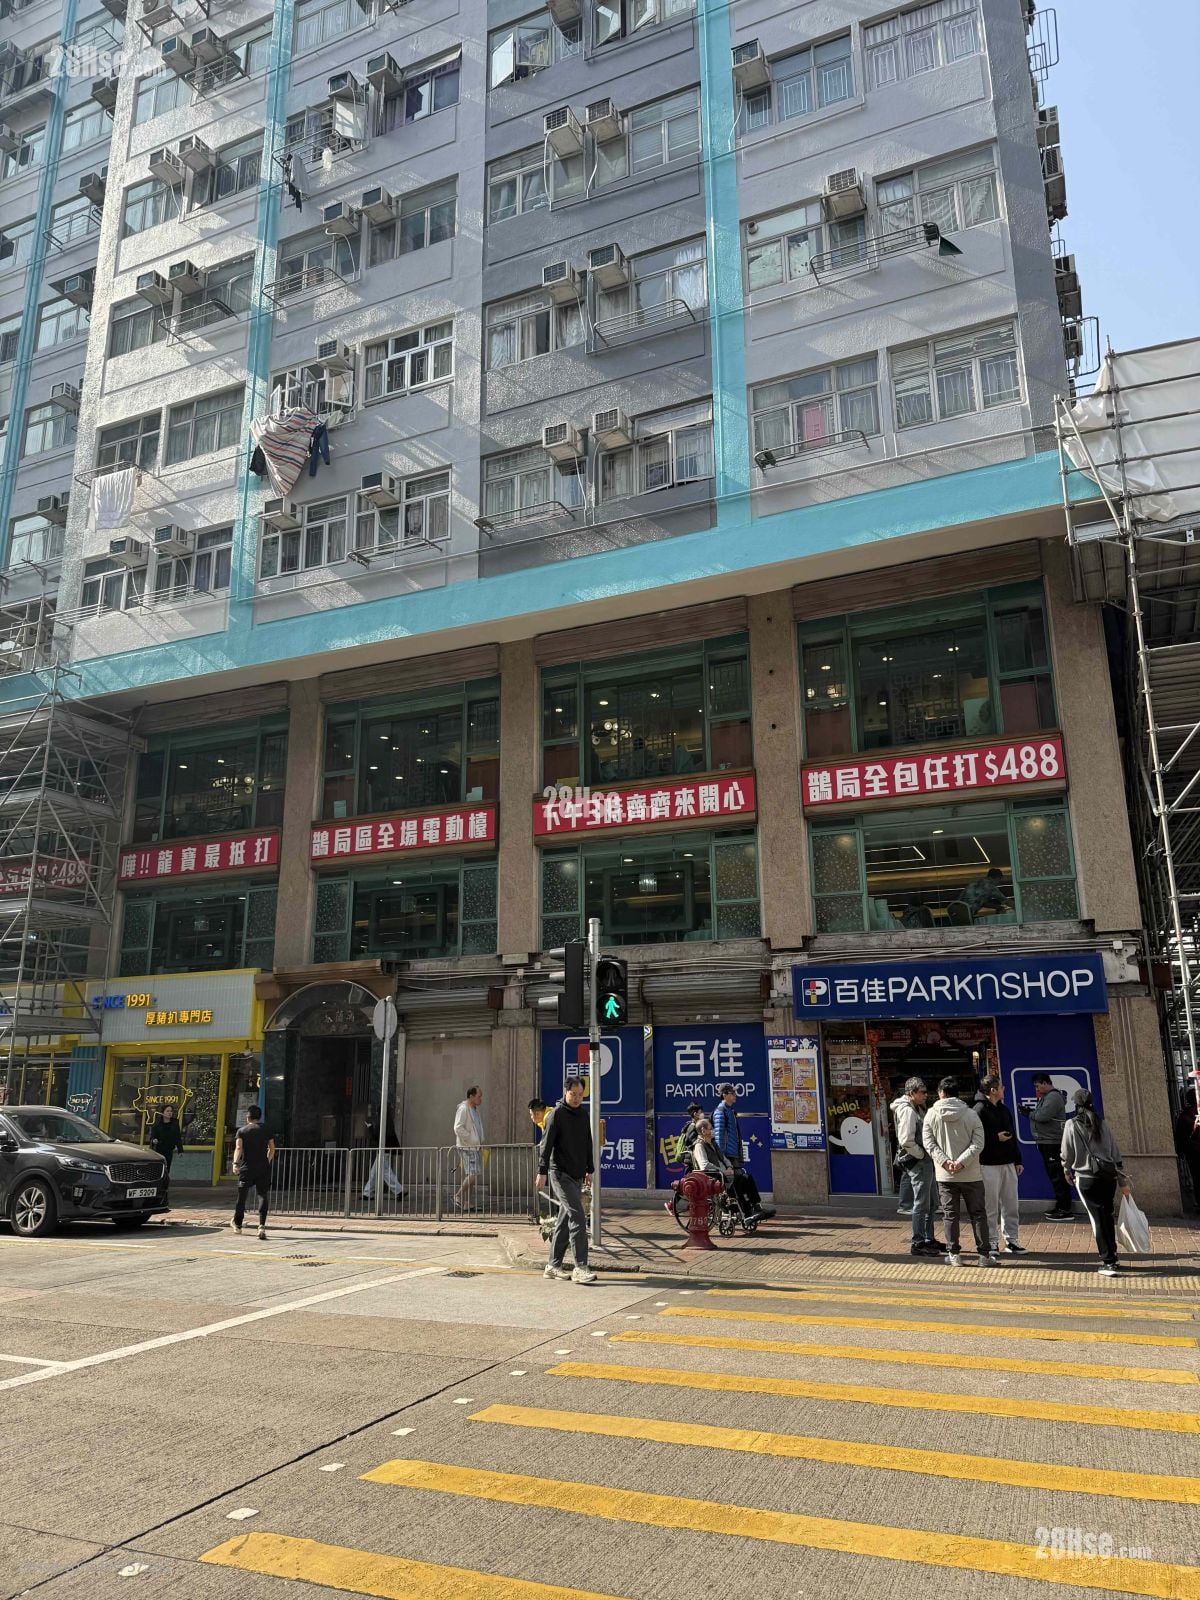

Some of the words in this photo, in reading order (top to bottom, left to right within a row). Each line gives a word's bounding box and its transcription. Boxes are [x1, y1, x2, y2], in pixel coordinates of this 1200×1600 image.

[834, 977, 887, 1004] 百佳
[92, 995, 124, 1009] SNCE
[126, 994, 151, 1008] 1991
[673, 1038, 745, 1077] 百佳
[665, 1083, 755, 1098] PARKnSOP
[164, 1095, 179, 1103] 1991
[827, 1099, 860, 1117] Hello!
